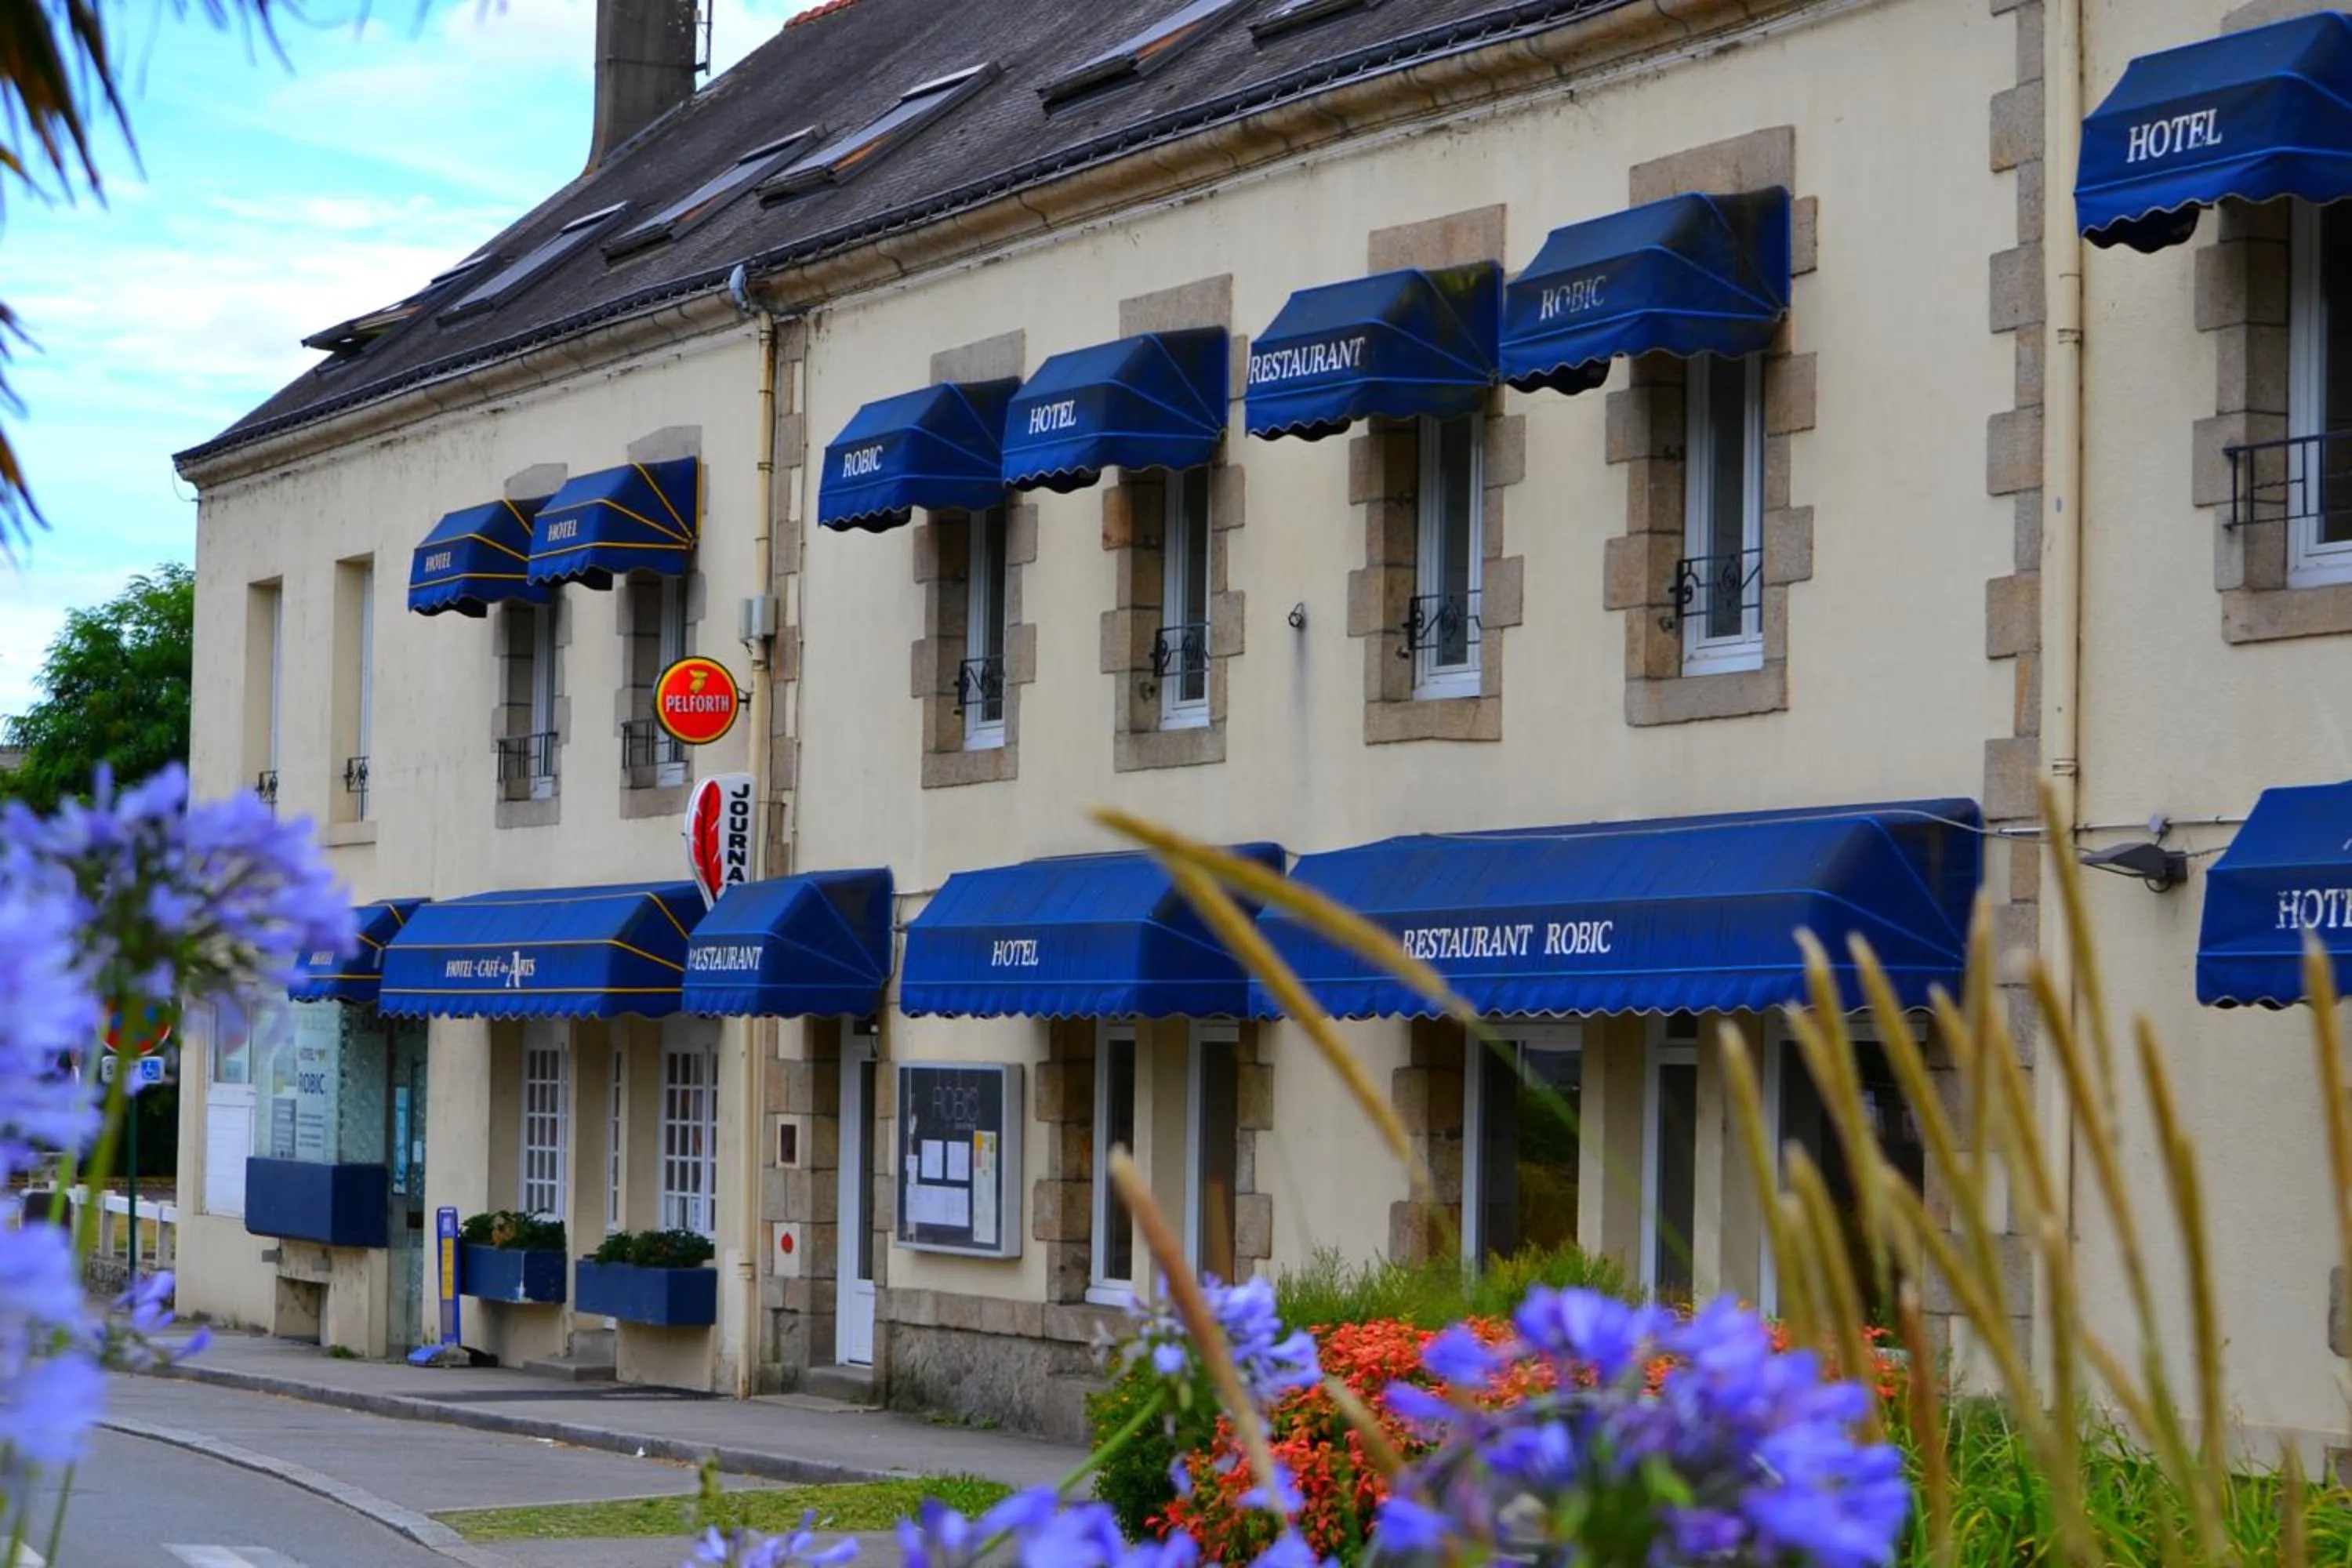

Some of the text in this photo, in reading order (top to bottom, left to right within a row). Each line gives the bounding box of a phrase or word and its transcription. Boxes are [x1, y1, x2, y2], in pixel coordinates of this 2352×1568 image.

[2125, 108, 2222, 162] HOTEL
[1540, 275, 1606, 320] ROBIC
[1249, 336, 1365, 384] RESTAURANT
[1028, 401, 1076, 434] HOTEL
[843, 445, 883, 477] ROBIC
[547, 519, 578, 542] HOTEL
[425, 551, 452, 572] HOTEL
[666, 695, 729, 713] PELFORTH
[726, 783, 750, 887] JOURNA
[991, 939, 1039, 967] HOTEL
[1403, 920, 1613, 959] RESTAURANT ROBIC
[505, 950, 535, 988] ARTS
[688, 946, 763, 970] RESTAURANT
